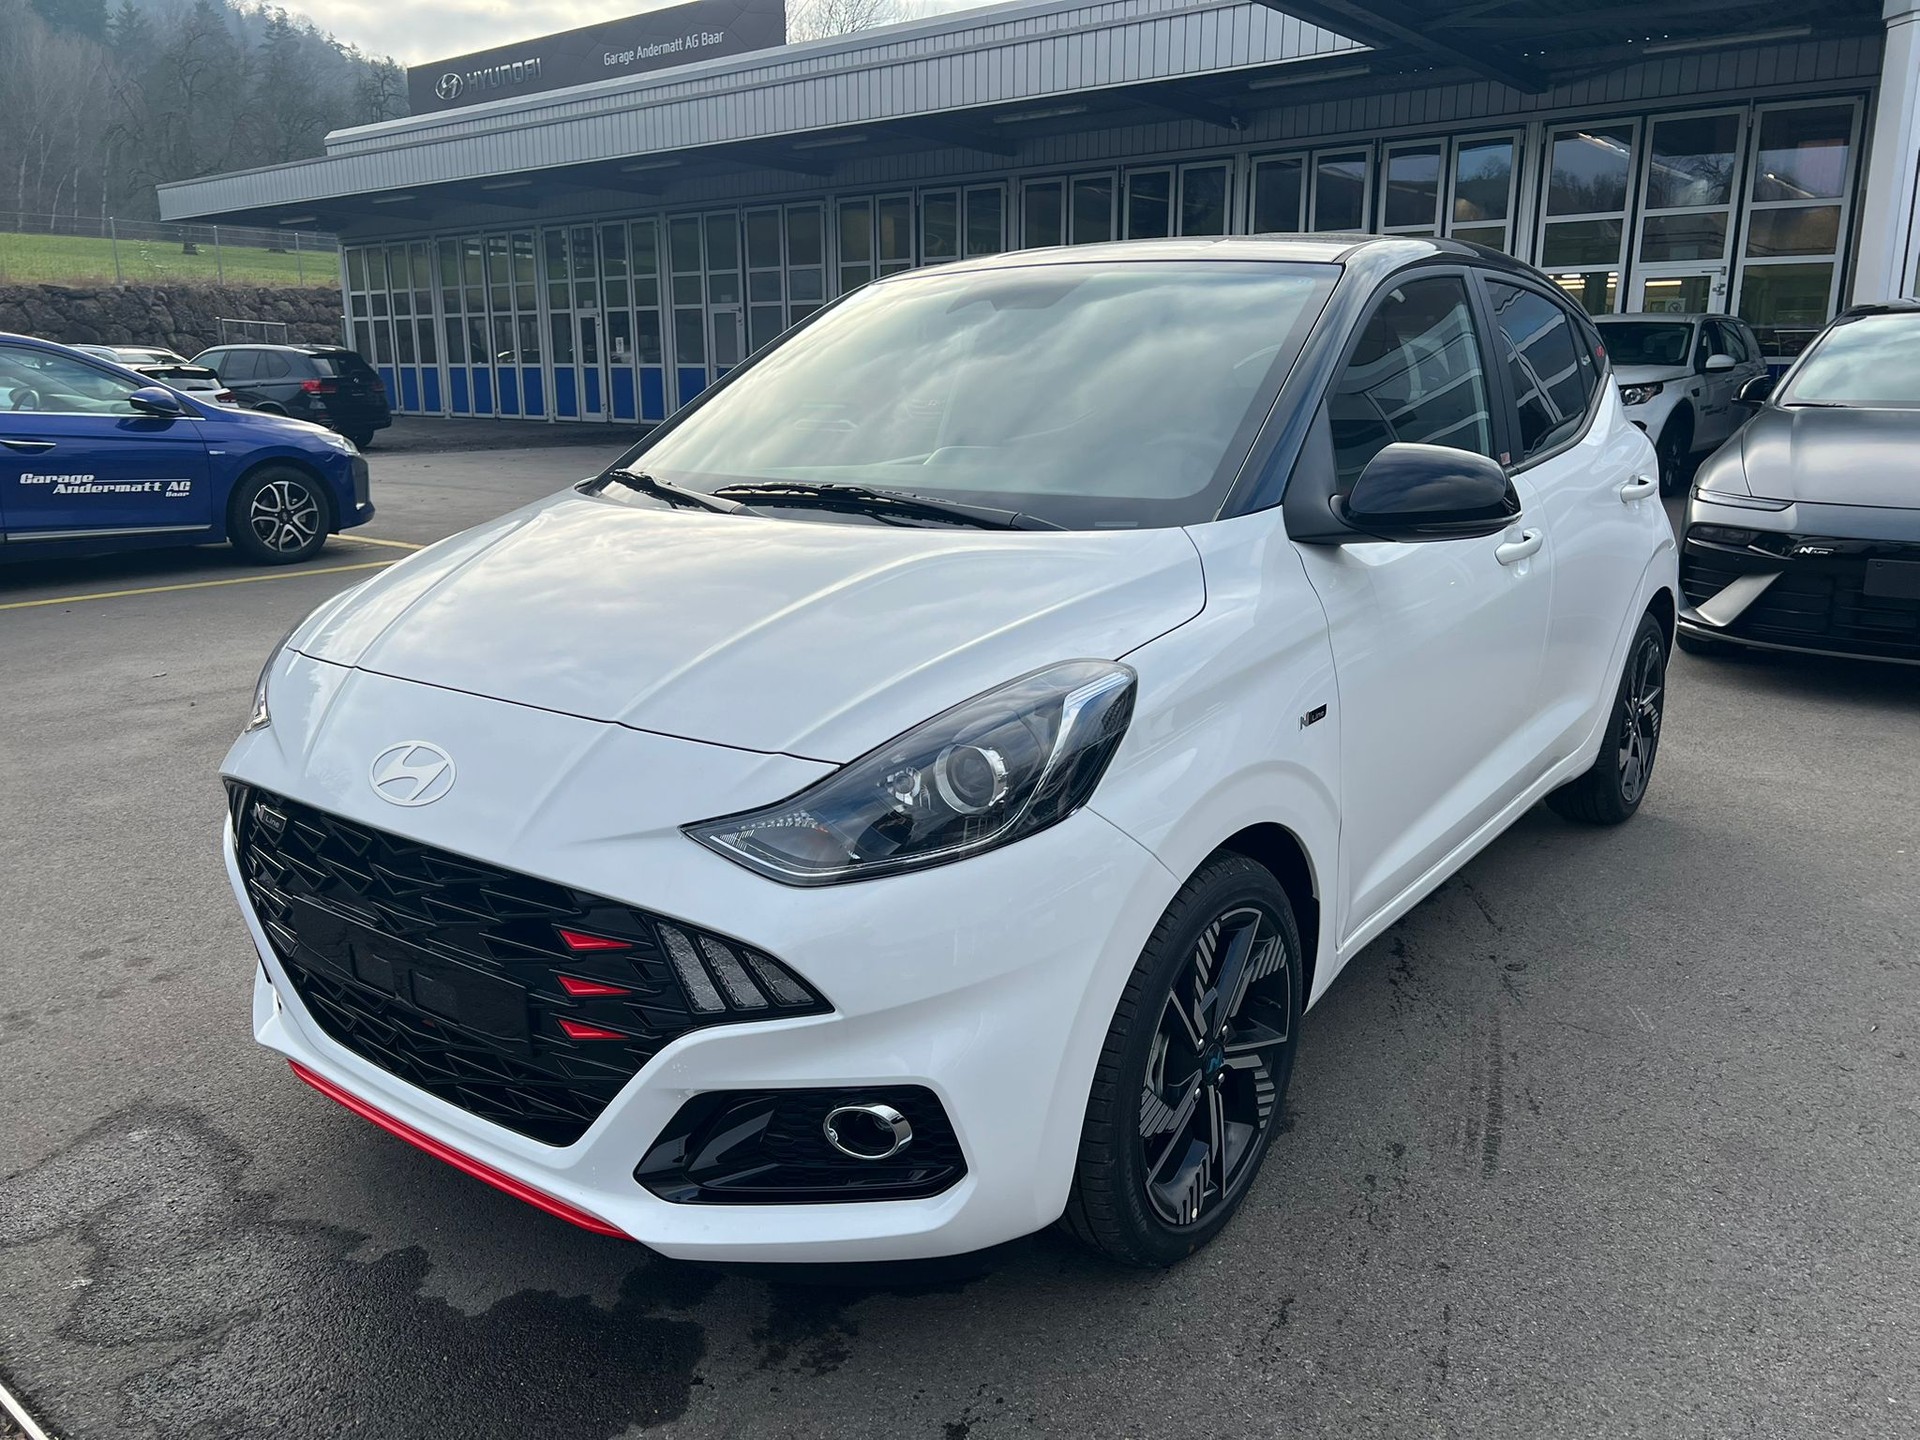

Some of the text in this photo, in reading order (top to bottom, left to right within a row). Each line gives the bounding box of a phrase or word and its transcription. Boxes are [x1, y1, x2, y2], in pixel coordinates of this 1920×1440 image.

[603, 31, 724, 66] Garage Andermatt AG Baar
[466, 57, 542, 91] HYUNDAI
[19, 473, 95, 485] Garage
[53, 480, 192, 495] Andermatt AG
[265, 814, 281, 829] Line
